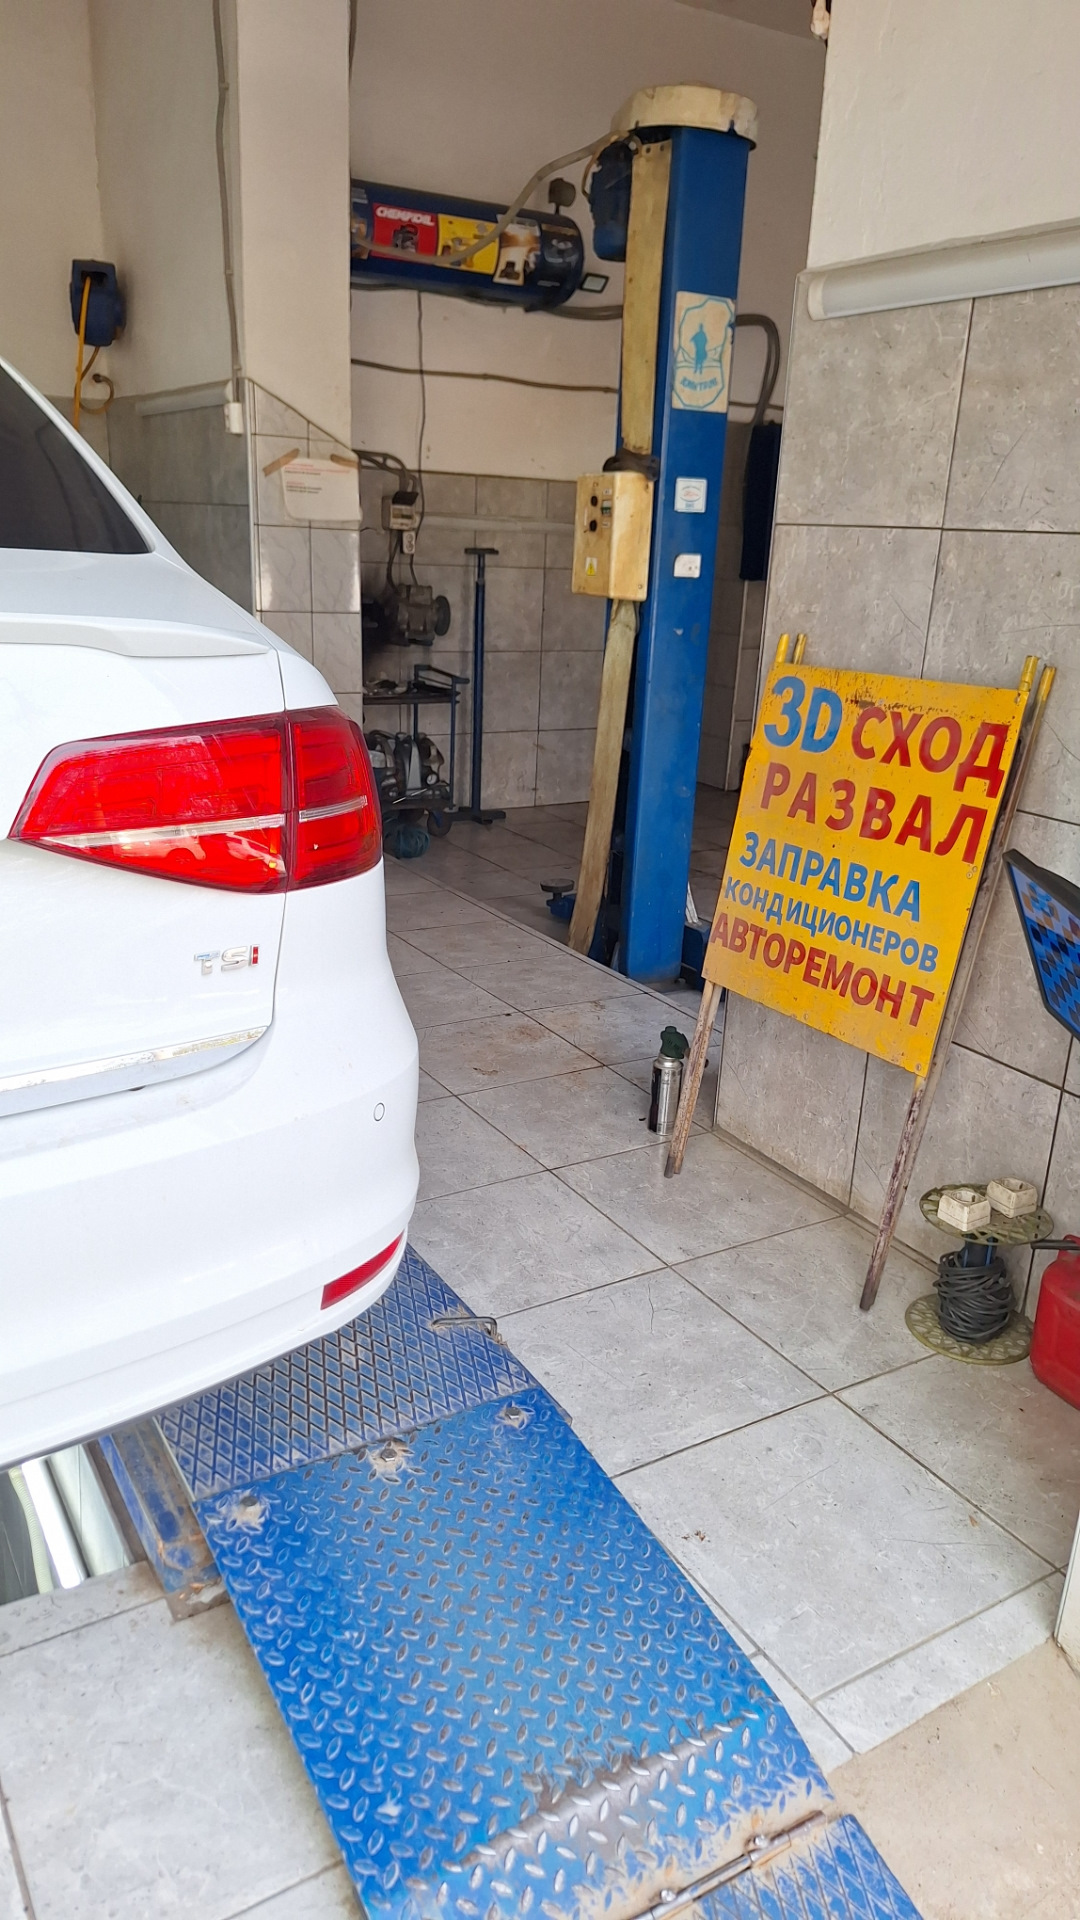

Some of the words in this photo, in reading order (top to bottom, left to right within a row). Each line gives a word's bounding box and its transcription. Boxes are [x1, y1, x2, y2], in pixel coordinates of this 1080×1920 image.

[764, 676, 842, 753] 3D
[852, 707, 1010, 798] СХОД
[760, 762, 988, 864] РАЗВАЛ
[724, 876, 939, 973] КОНДИЦИОНЕРОВ
[740, 831, 920, 922] ЗАПРАВКА
[193, 944, 259, 975] TSI
[709, 913, 935, 1027] АВТОРЕМОНТ
